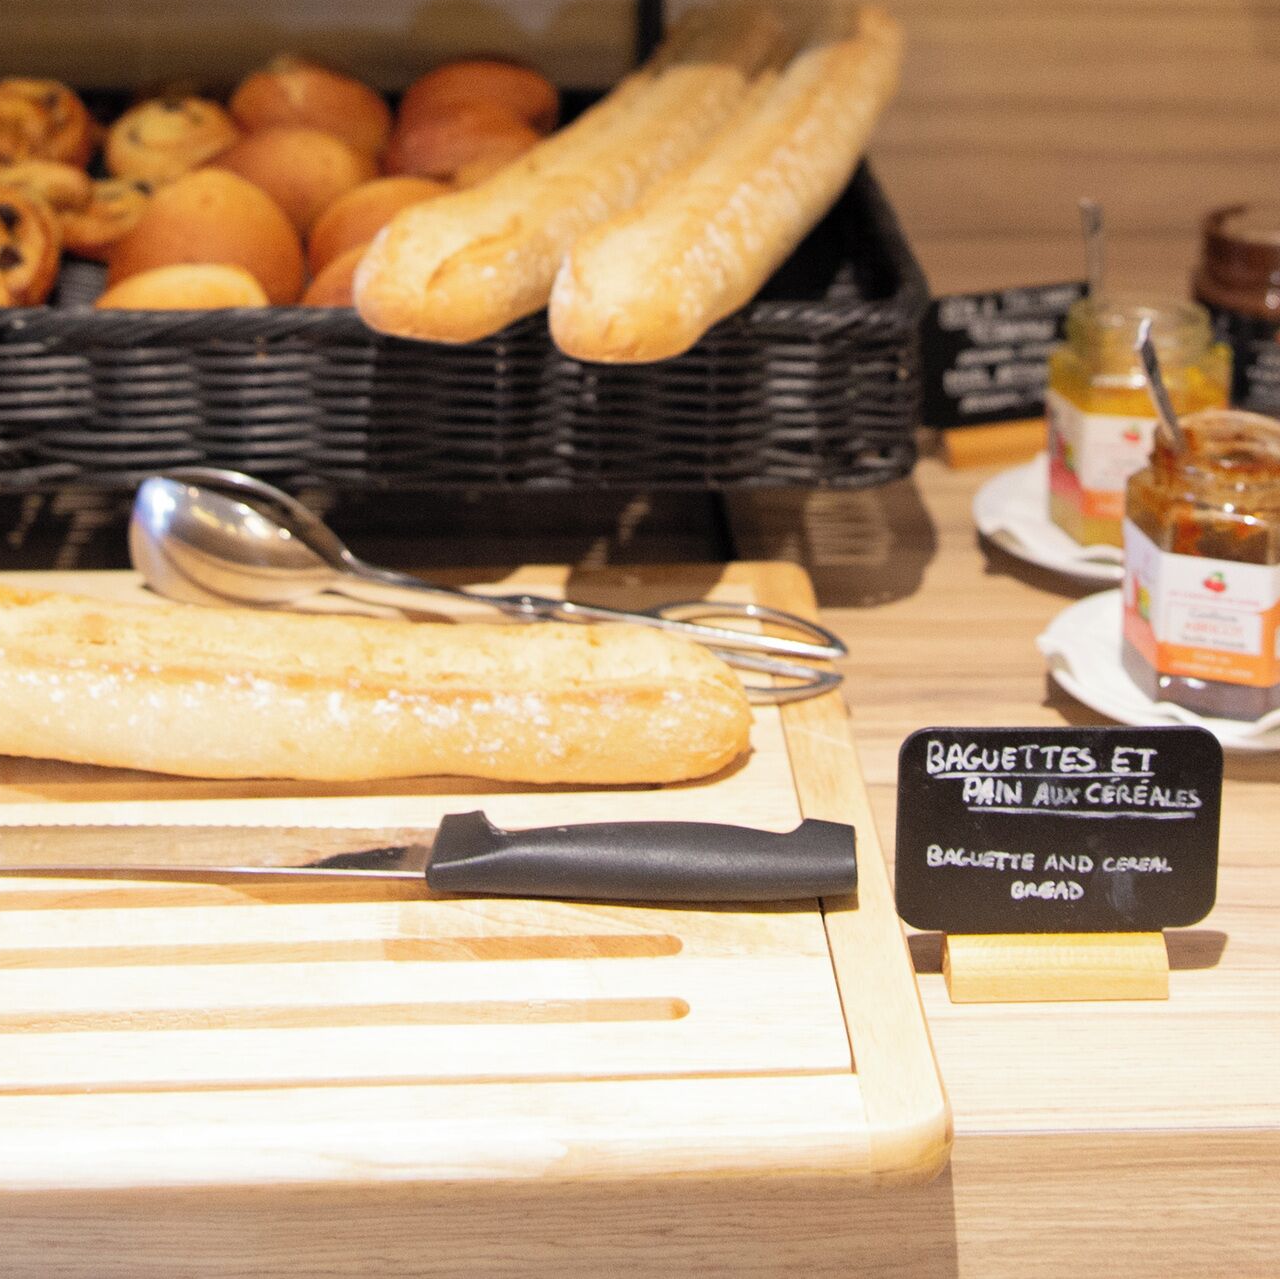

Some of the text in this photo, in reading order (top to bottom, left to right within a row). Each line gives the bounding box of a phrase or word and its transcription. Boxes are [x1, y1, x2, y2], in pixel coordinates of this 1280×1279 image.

[926, 740, 1158, 776] BAGUETTES ET
[962, 777, 1203, 808] PAIN AUX CÉRÉALES
[926, 844, 1174, 873] BAGUETTE AND CEREAL
[1010, 880, 1085, 900] BREAD
